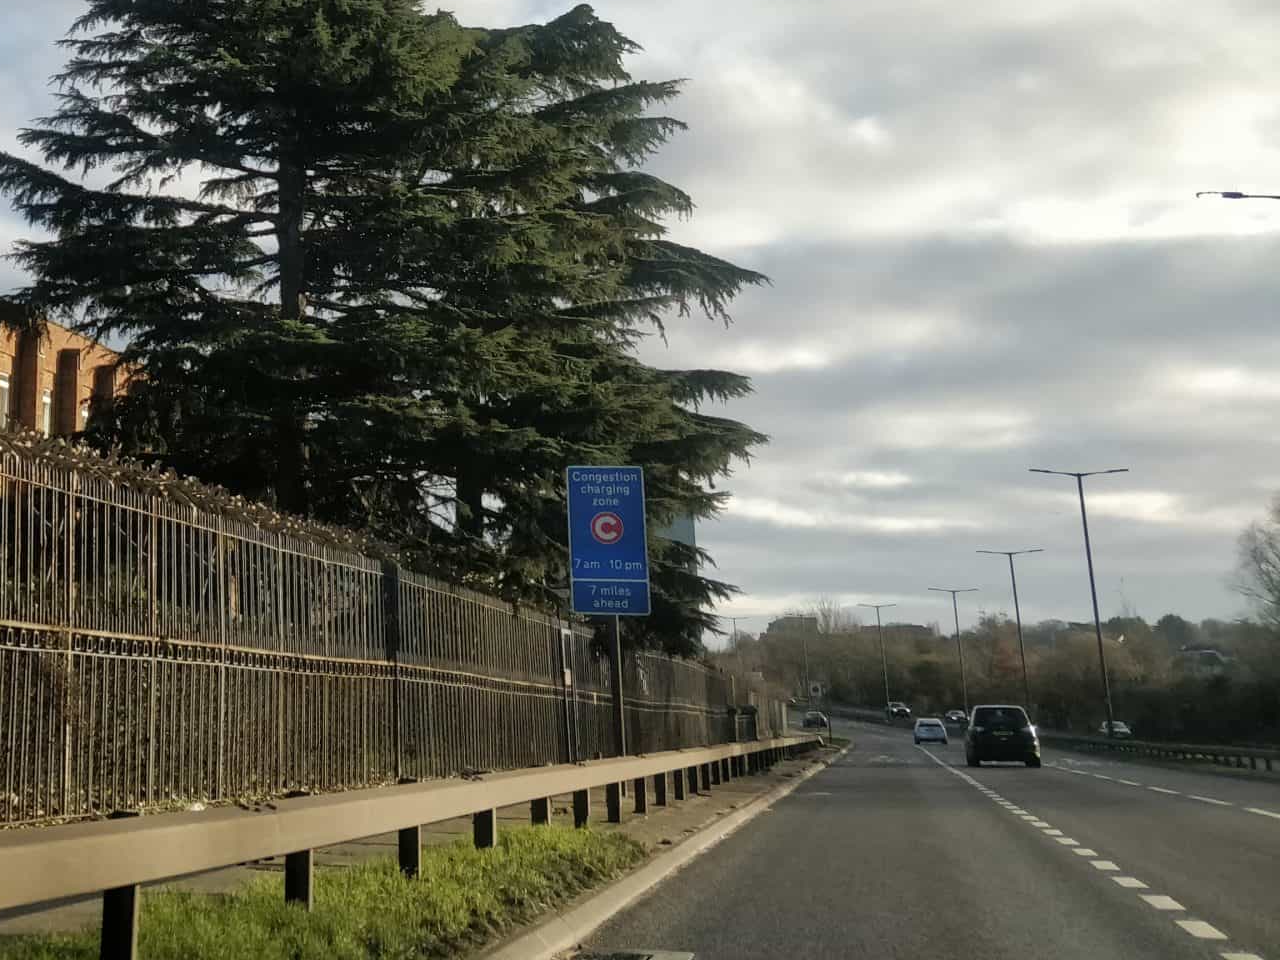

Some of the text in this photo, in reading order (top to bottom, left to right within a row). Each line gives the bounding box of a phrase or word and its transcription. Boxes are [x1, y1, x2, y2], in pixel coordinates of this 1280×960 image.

[572, 471, 638, 483] Congestion
[580, 484, 630, 496] charging
[592, 497, 619, 506] zone
[589, 584, 631, 597] 7 miles
[593, 598, 629, 609] ahead
